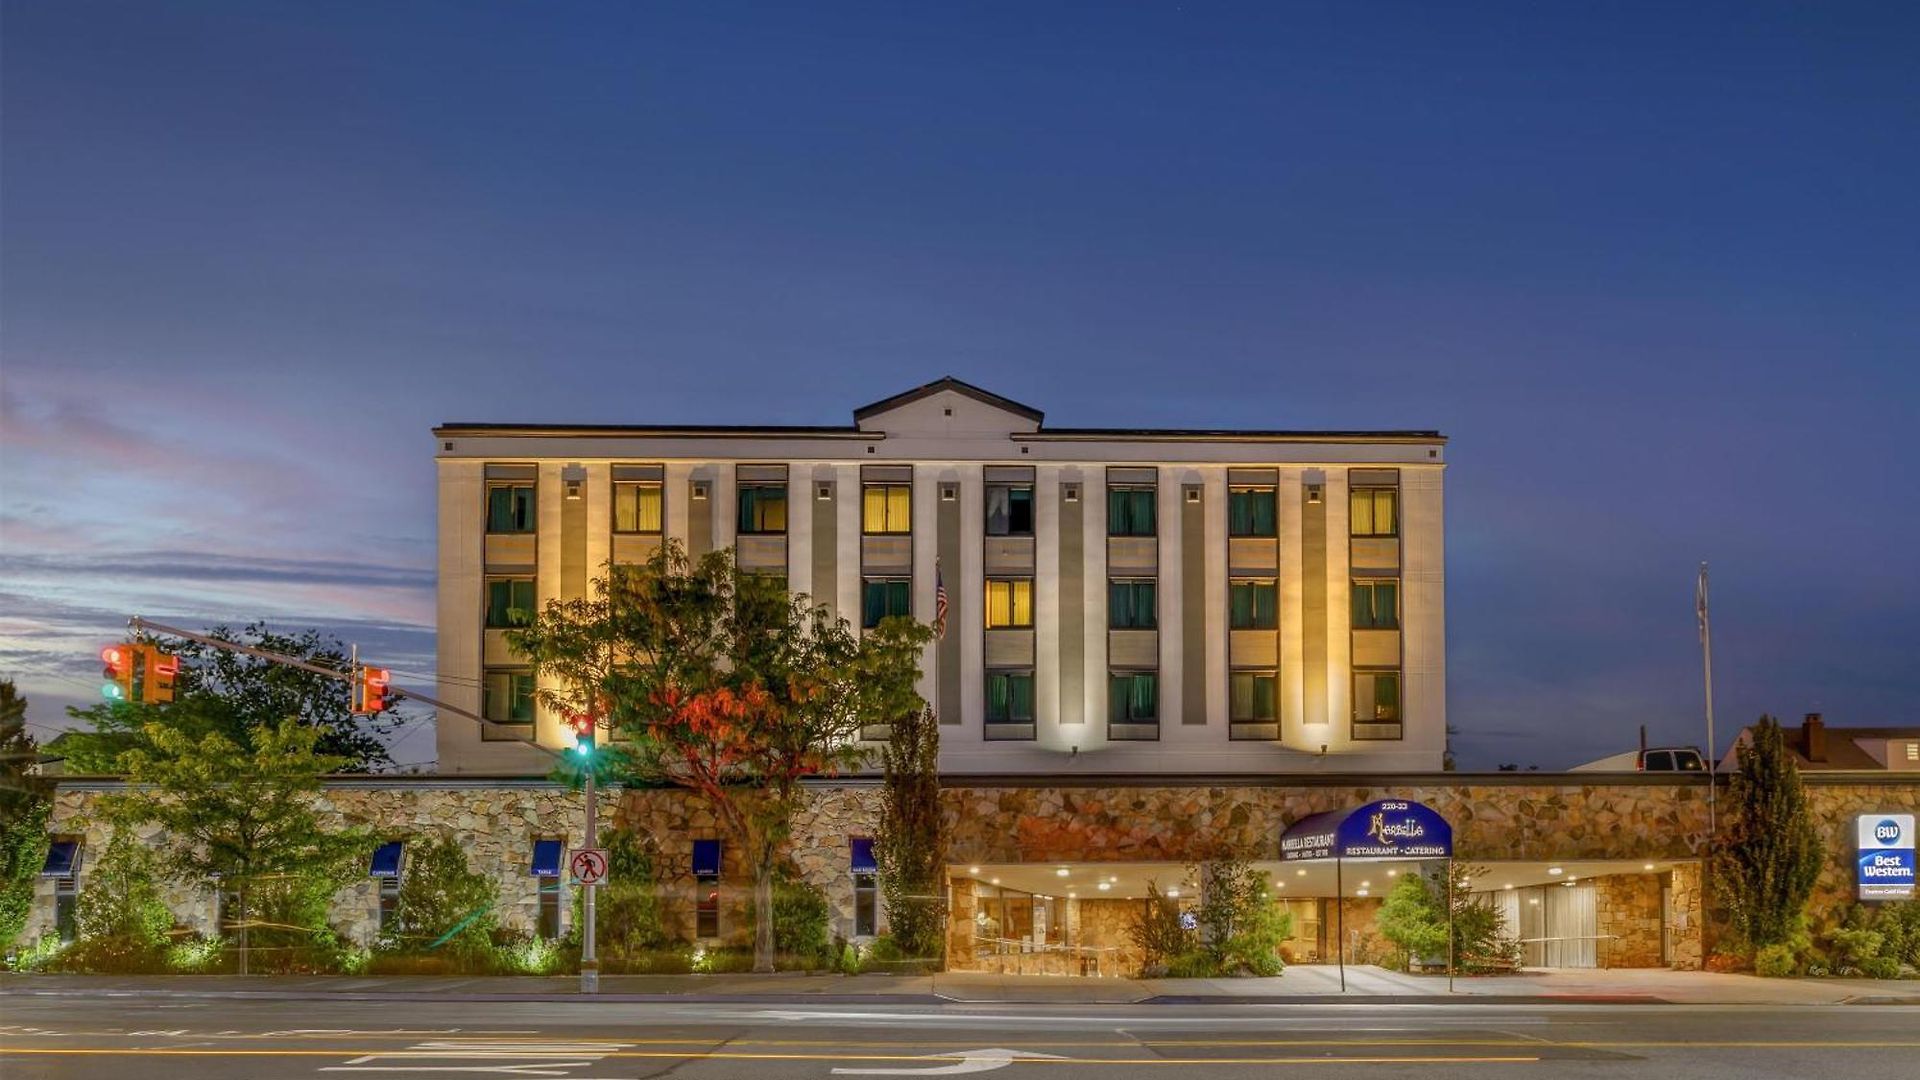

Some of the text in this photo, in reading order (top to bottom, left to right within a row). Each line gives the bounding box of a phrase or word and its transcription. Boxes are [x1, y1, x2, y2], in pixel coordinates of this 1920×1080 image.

[1877, 826, 1898, 838] BW
[1346, 847, 1444, 855] RESTAURANT CATERING
[1875, 855, 1901, 866] Best
